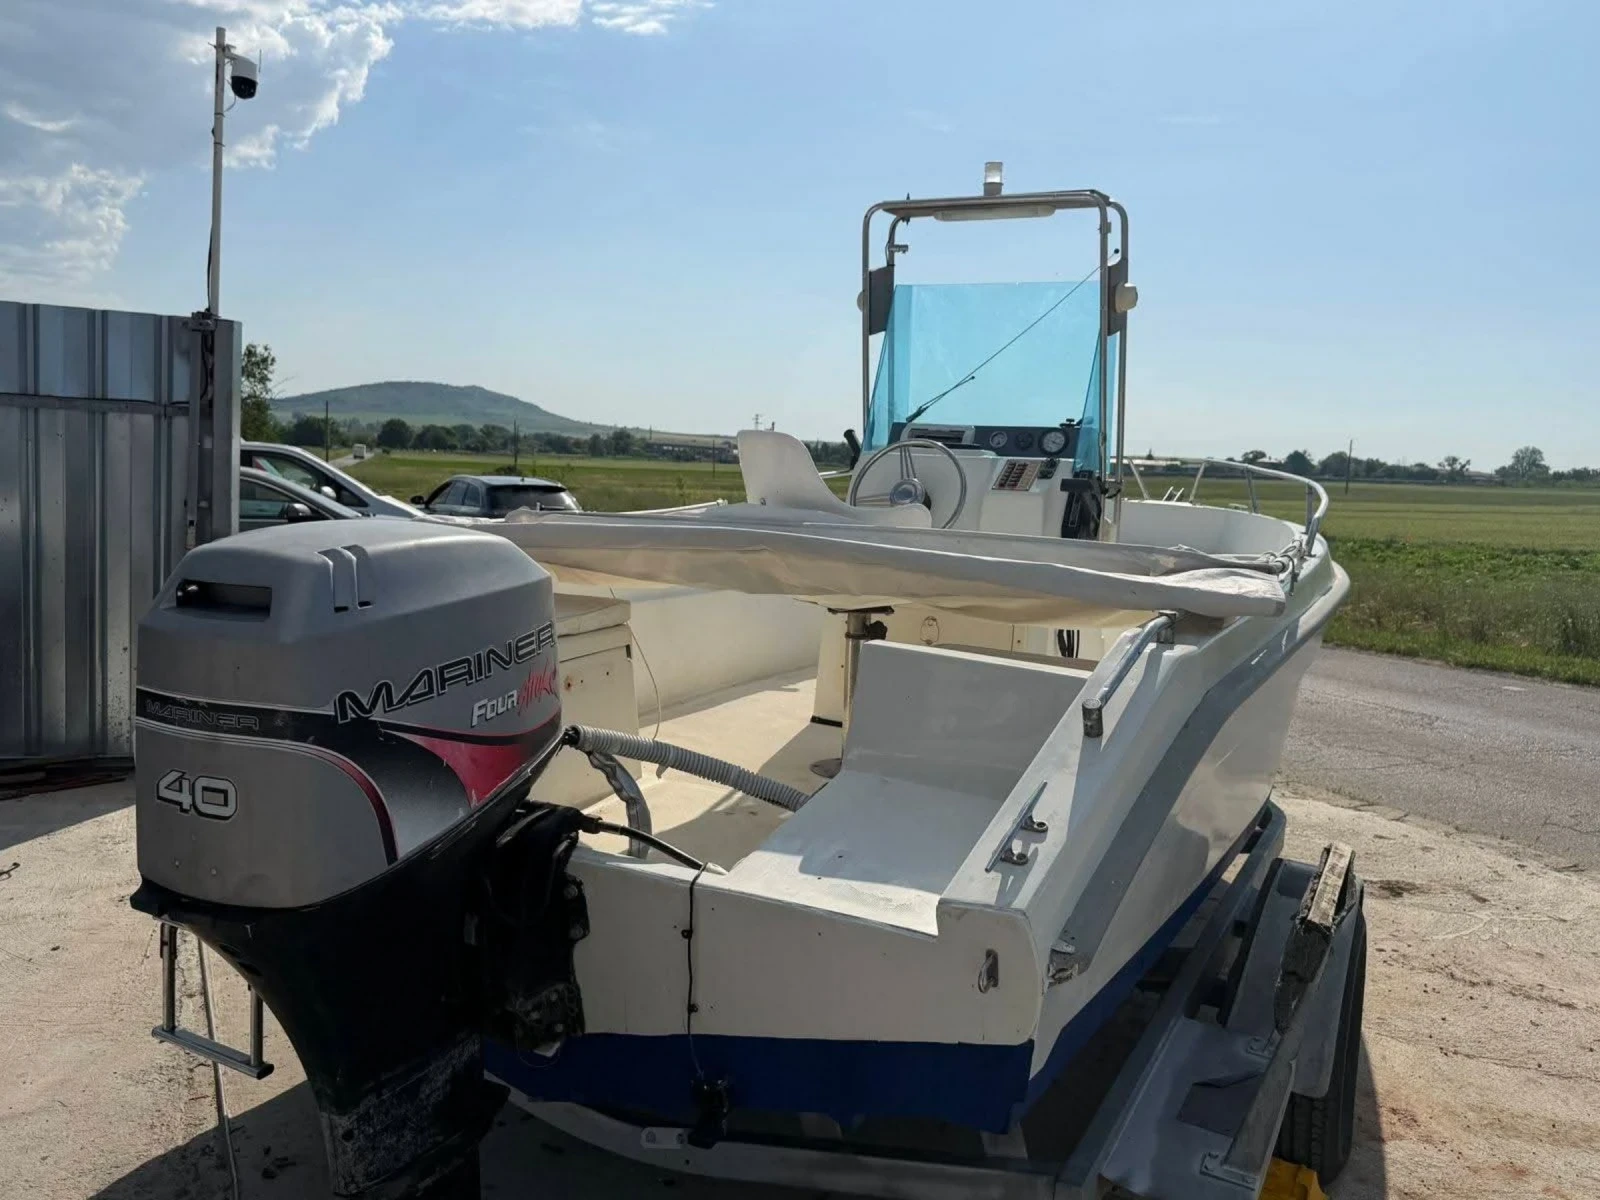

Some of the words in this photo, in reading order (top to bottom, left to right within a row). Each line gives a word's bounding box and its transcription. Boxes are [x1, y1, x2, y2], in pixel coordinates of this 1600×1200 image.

[334, 620, 555, 724] MARINER
[146, 700, 260, 731] MARINER
[156, 769, 238, 821] 40
